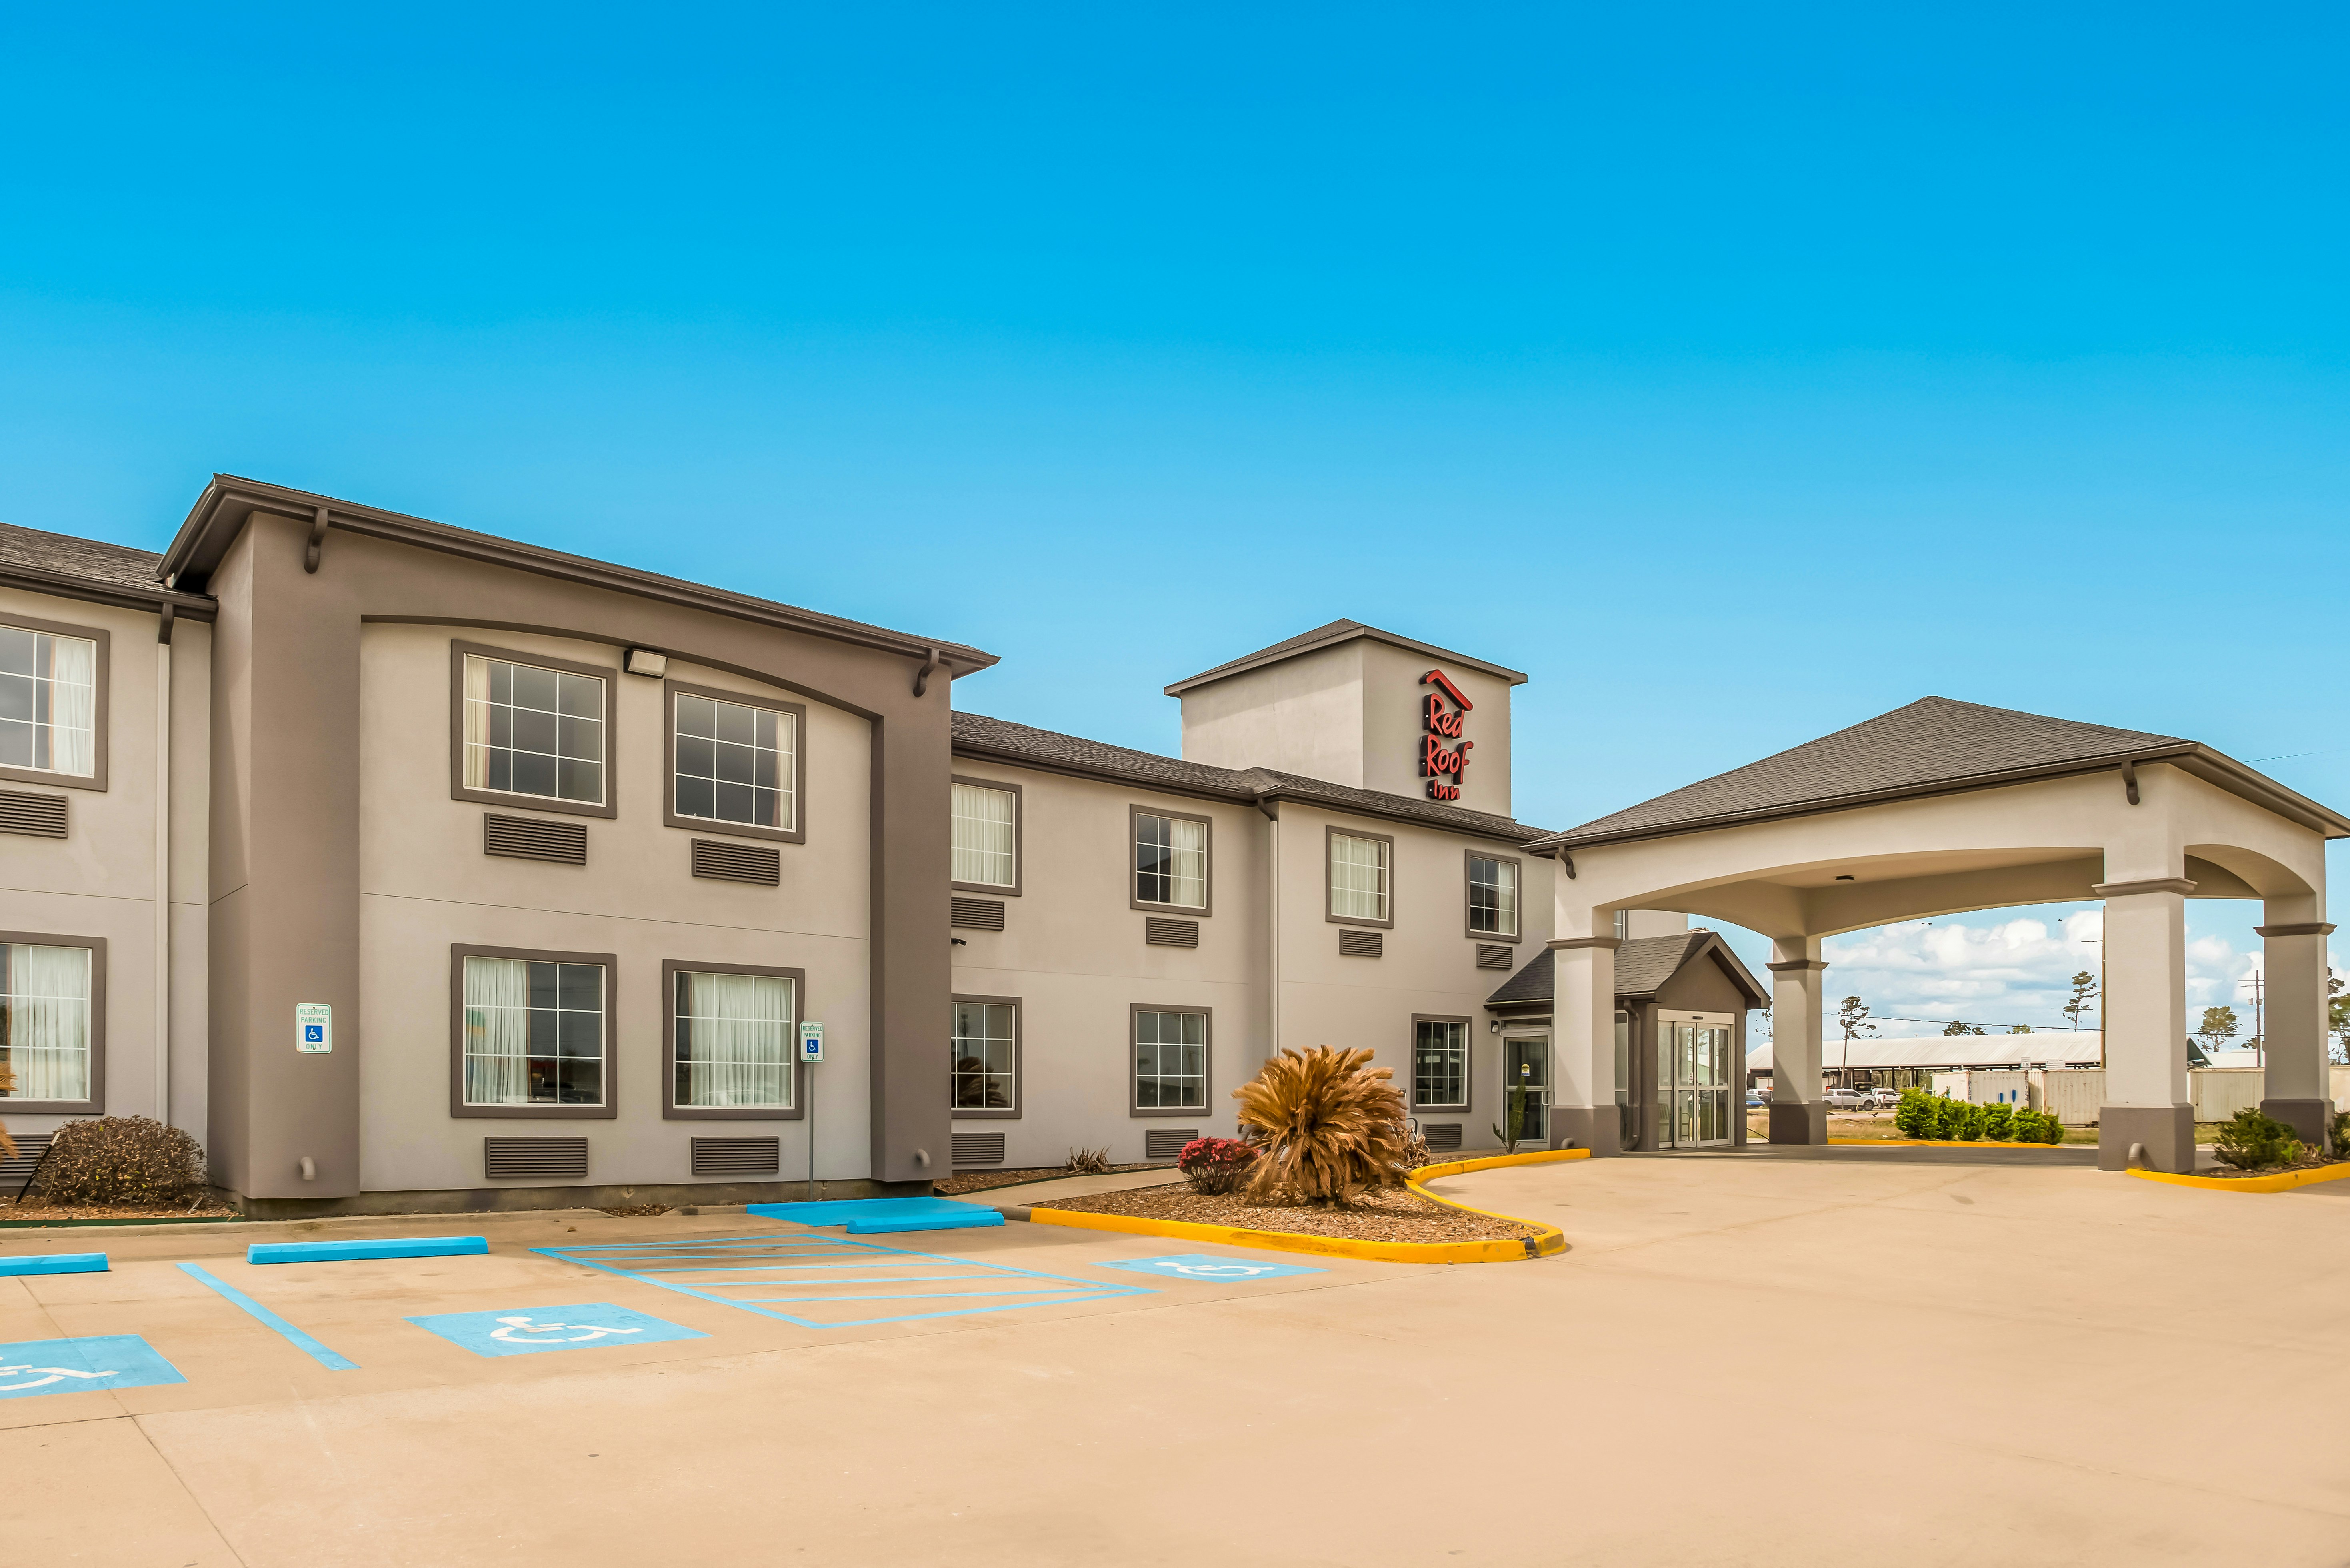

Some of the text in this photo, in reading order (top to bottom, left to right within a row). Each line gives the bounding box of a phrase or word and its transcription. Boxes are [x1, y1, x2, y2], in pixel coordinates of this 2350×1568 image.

[1428, 693, 1465, 738] Red
[1425, 734, 1474, 785] Roof
[1432, 779, 1460, 800] Inn
